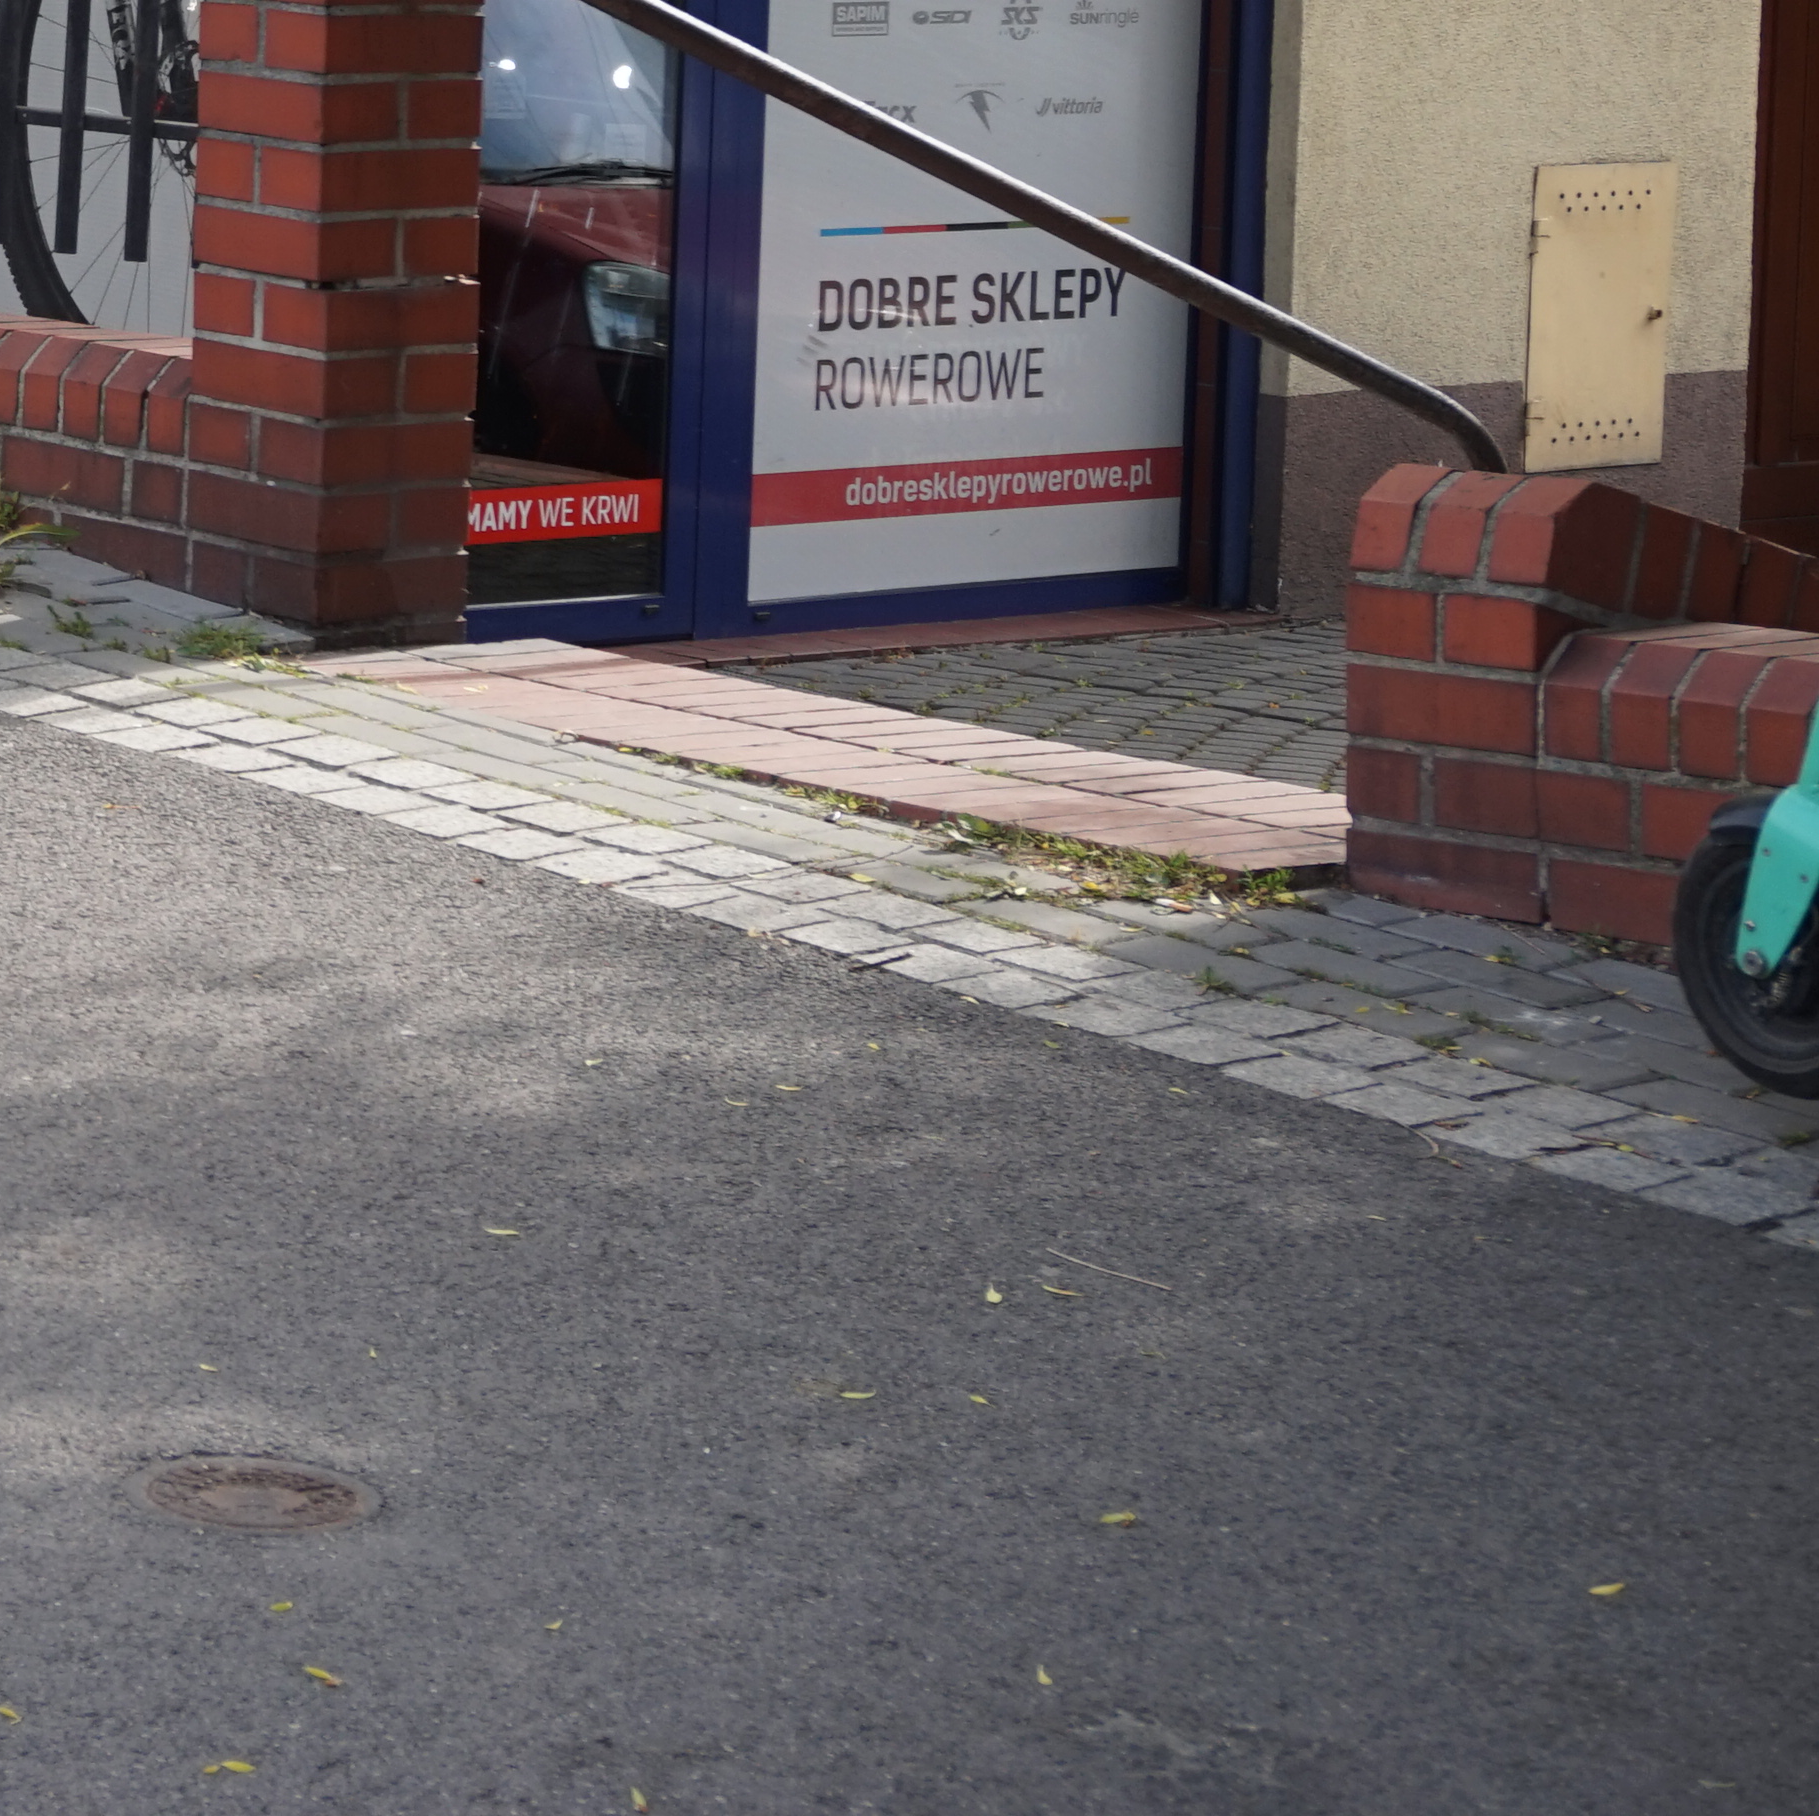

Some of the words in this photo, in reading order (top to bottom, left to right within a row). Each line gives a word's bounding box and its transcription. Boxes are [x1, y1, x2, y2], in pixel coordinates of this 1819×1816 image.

[835, 4, 887, 23] SAPIM
[1051, 96, 1104, 115] vittoria
[817, 273, 958, 332] DOBRE
[971, 267, 1128, 325] SKLEPY
[813, 346, 1045, 411] ROWEROWE
[845, 458, 1152, 506] dobresklepyrowerowe.pl
[467, 499, 533, 533] MAMY
[538, 496, 575, 528] WE
[581, 493, 640, 526] KRWI
